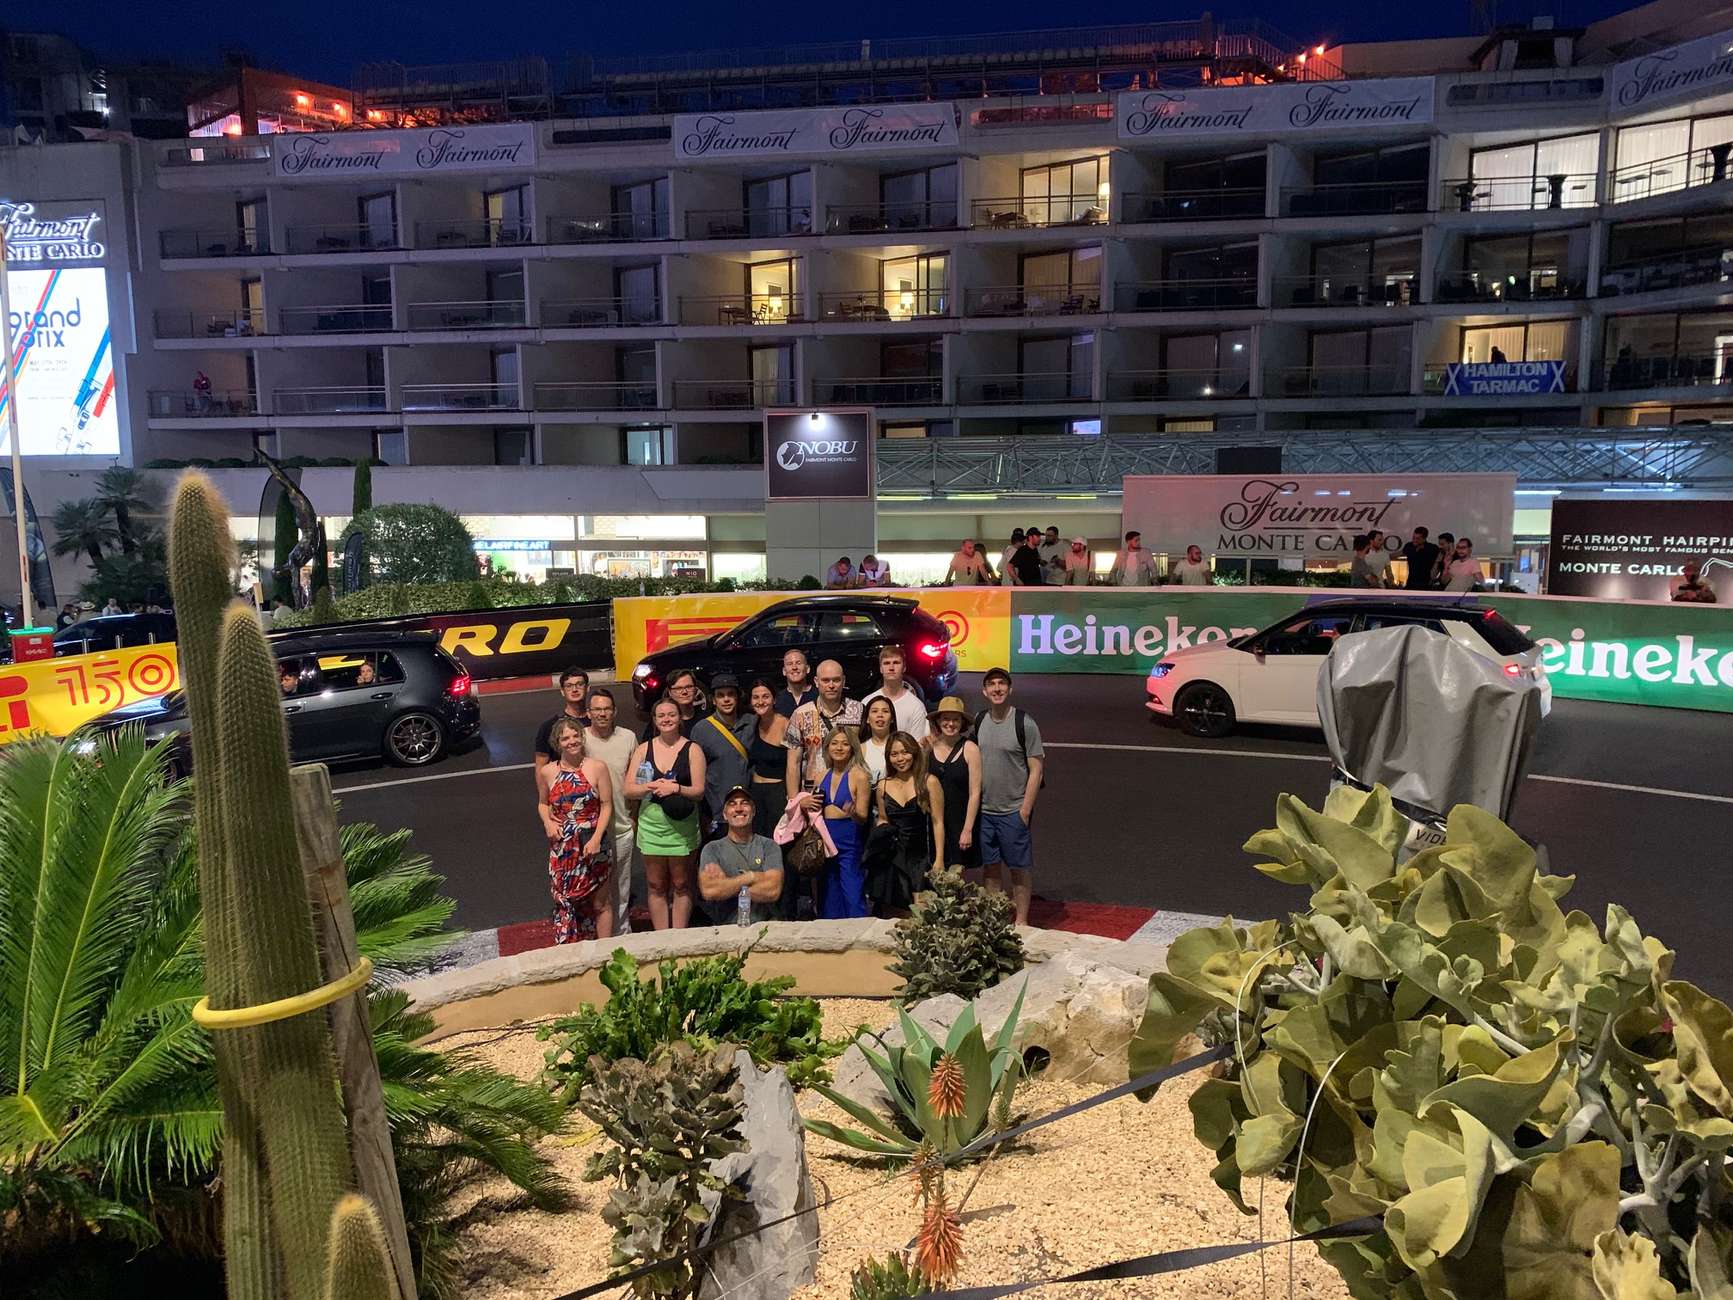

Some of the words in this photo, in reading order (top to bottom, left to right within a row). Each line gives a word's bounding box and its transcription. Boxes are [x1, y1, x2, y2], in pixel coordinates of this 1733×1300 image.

[1619, 50, 1733, 108] Fairmon
[1126, 93, 1257, 135] Fairmont
[1289, 84, 1423, 128] Fairmont
[682, 115, 800, 156] Fairmont
[829, 108, 948, 150] Fairmont
[282, 135, 387, 174] Fairmont
[416, 129, 526, 169] Fairmont
[7, 243, 43, 262] NTE
[46, 242, 105, 259] CARLO
[1464, 362, 1548, 377] HAMILTON
[1470, 379, 1541, 394] TARMAC
[796, 440, 859, 455] NOBU
[1220, 479, 1402, 532] Fairmont
[1217, 533, 1304, 551] MONTE
[1315, 534, 1402, 551] CAO
[1562, 534, 1653, 545] FAIRMONT
[1665, 546, 1708, 554] FAMOUS
[1559, 562, 1622, 574] MONTE
[440, 618, 572, 657] RO
